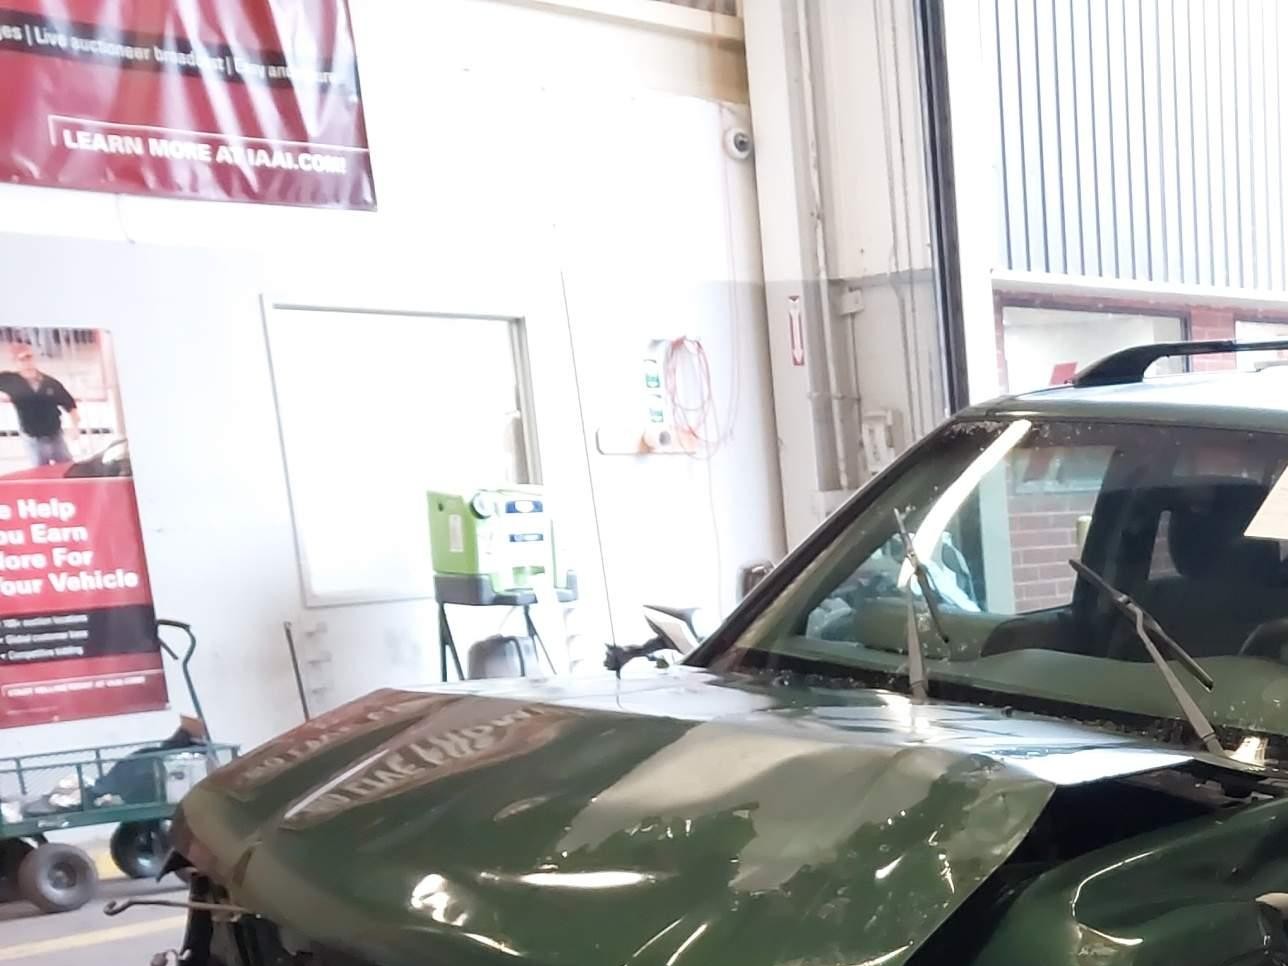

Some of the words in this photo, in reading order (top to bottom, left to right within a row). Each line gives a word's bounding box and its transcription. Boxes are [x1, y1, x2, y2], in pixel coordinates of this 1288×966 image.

[0, 24, 22, 41] es
[34, 25, 67, 49] Live
[62, 129, 144, 156] LEARN
[148, 137, 213, 162] MORE
[216, 144, 245, 165] AT
[0, 504, 12, 520] e
[16, 497, 76, 521] Help
[0, 529, 25, 545] ou
[30, 523, 88, 544] Earn
[0, 550, 47, 571] ore
[51, 546, 94, 568] For
[0, 576, 43, 597] our
[47, 568, 140, 593] Vehicle
